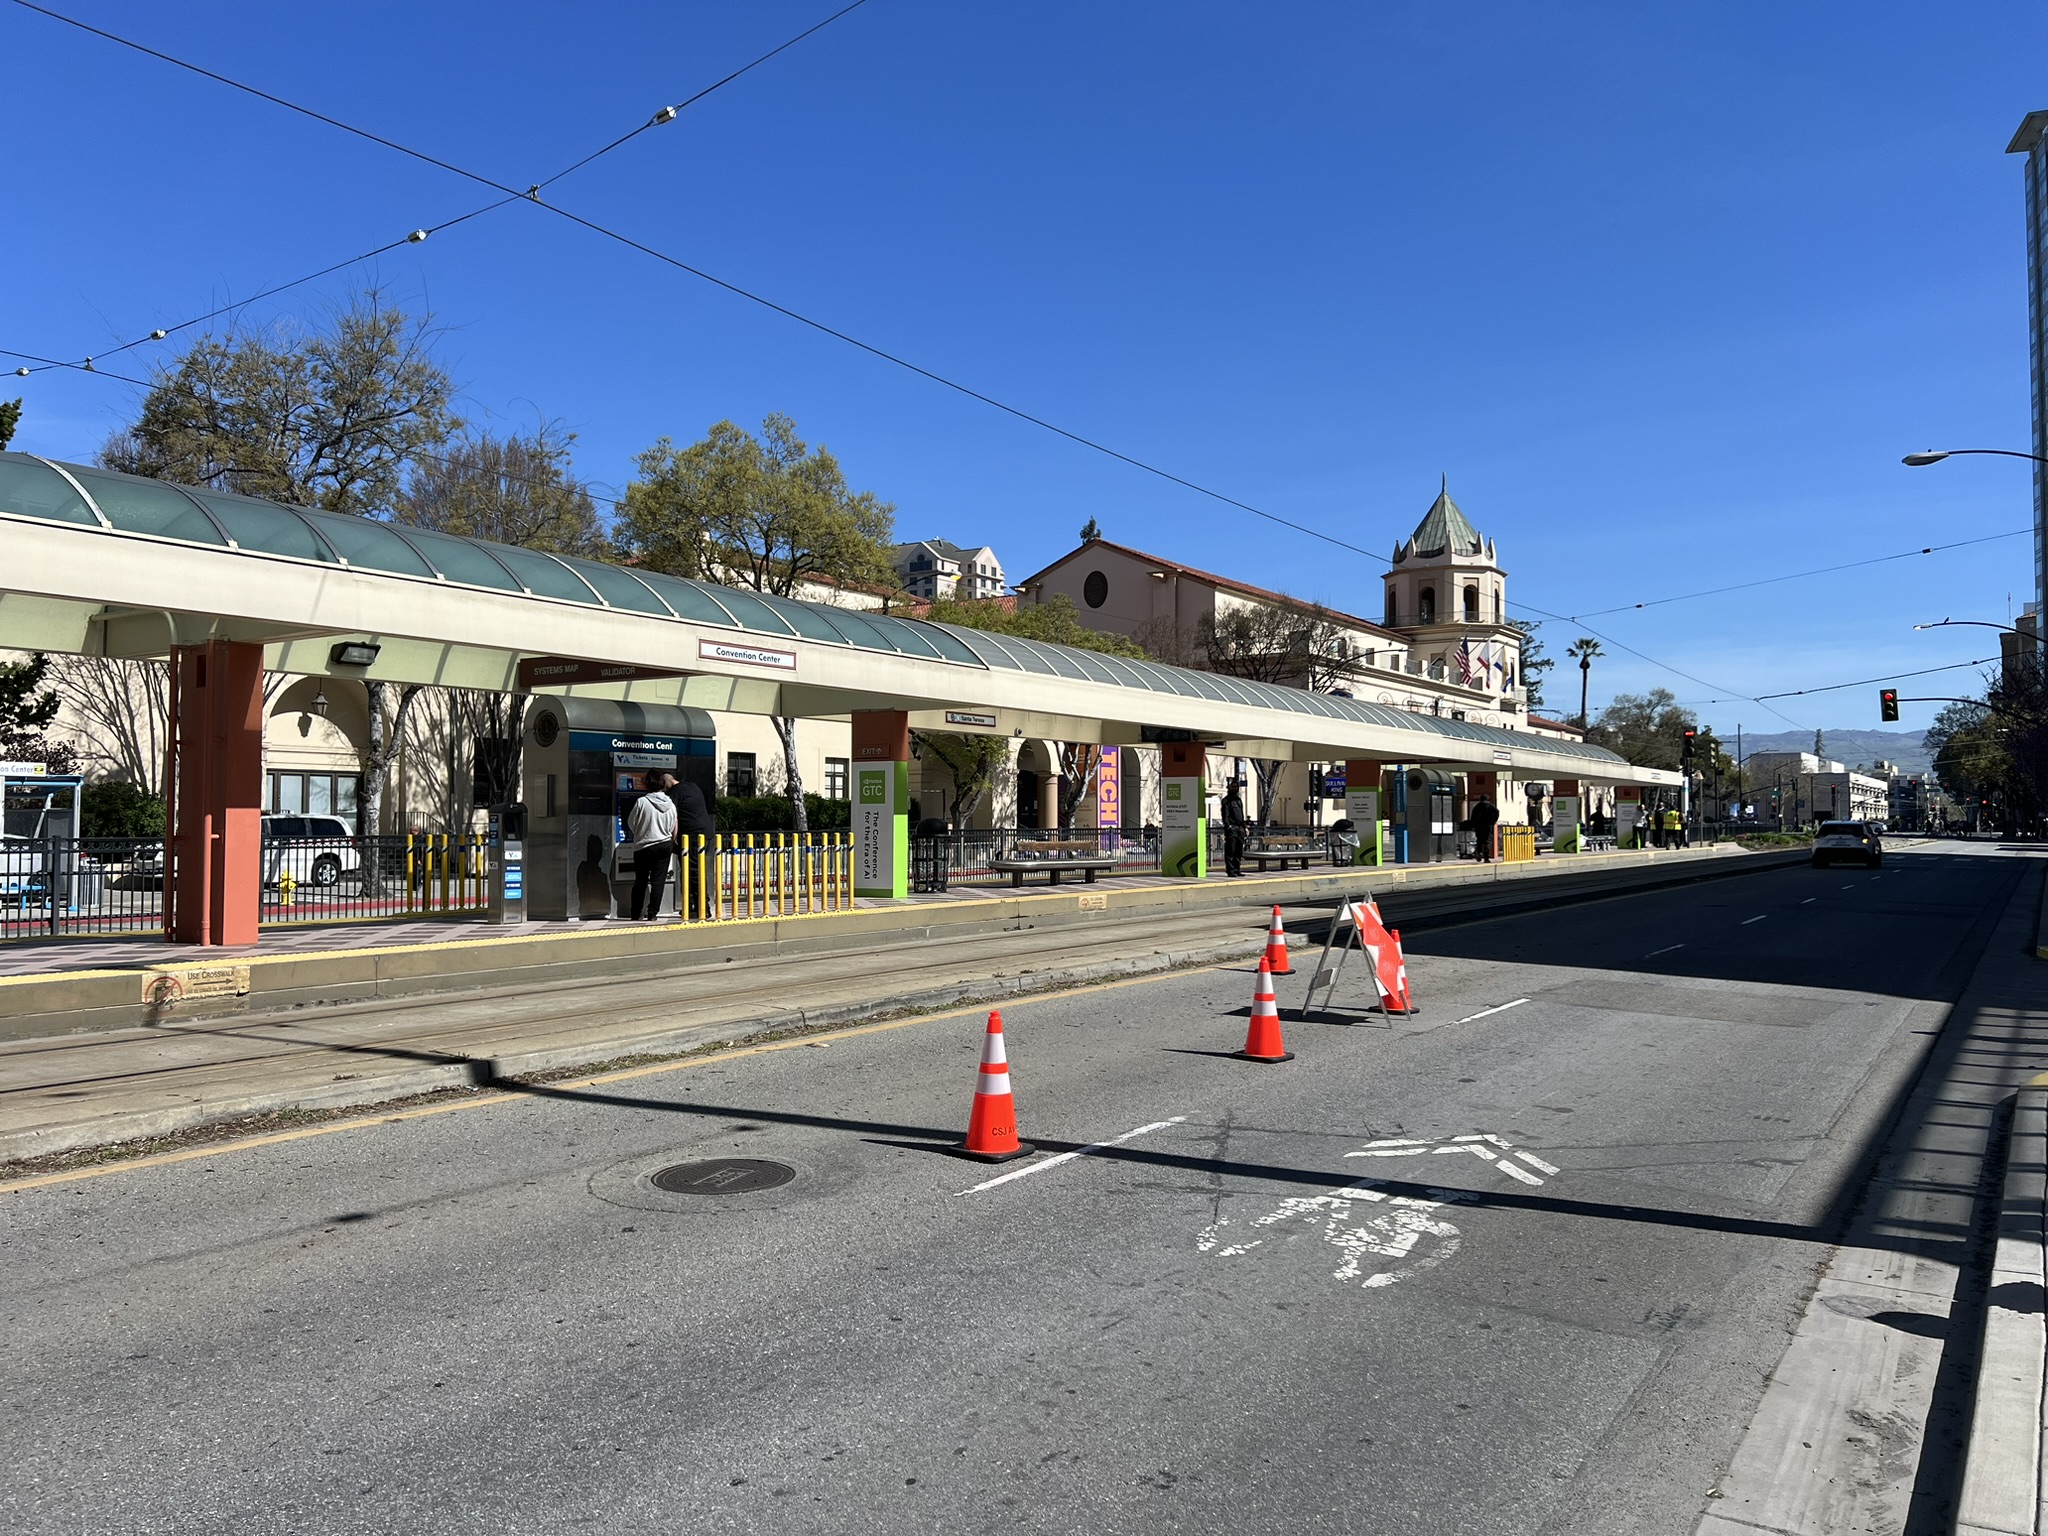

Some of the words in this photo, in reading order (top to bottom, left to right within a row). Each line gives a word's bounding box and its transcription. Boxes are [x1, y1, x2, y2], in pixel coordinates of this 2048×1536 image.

[715, 647, 757, 661] Convention
[758, 653, 781, 664] Center
[534, 665, 563, 675] SYSTEMS
[564, 664, 579, 673] MAP
[600, 666, 636, 676] VALIDATOR
[611, 738, 655, 750] Convention
[655, 741, 673, 751] Cent
[11, 765, 34, 773] Center
[862, 785, 882, 796] GTC
[1100, 751, 1118, 821] TECH
[864, 859, 871, 869] of
[864, 870, 870, 880] AI
[187, 972, 200, 980] USE
[201, 970, 235, 979] CROSSWALK
[992, 1127, 1007, 1136] CSJ
